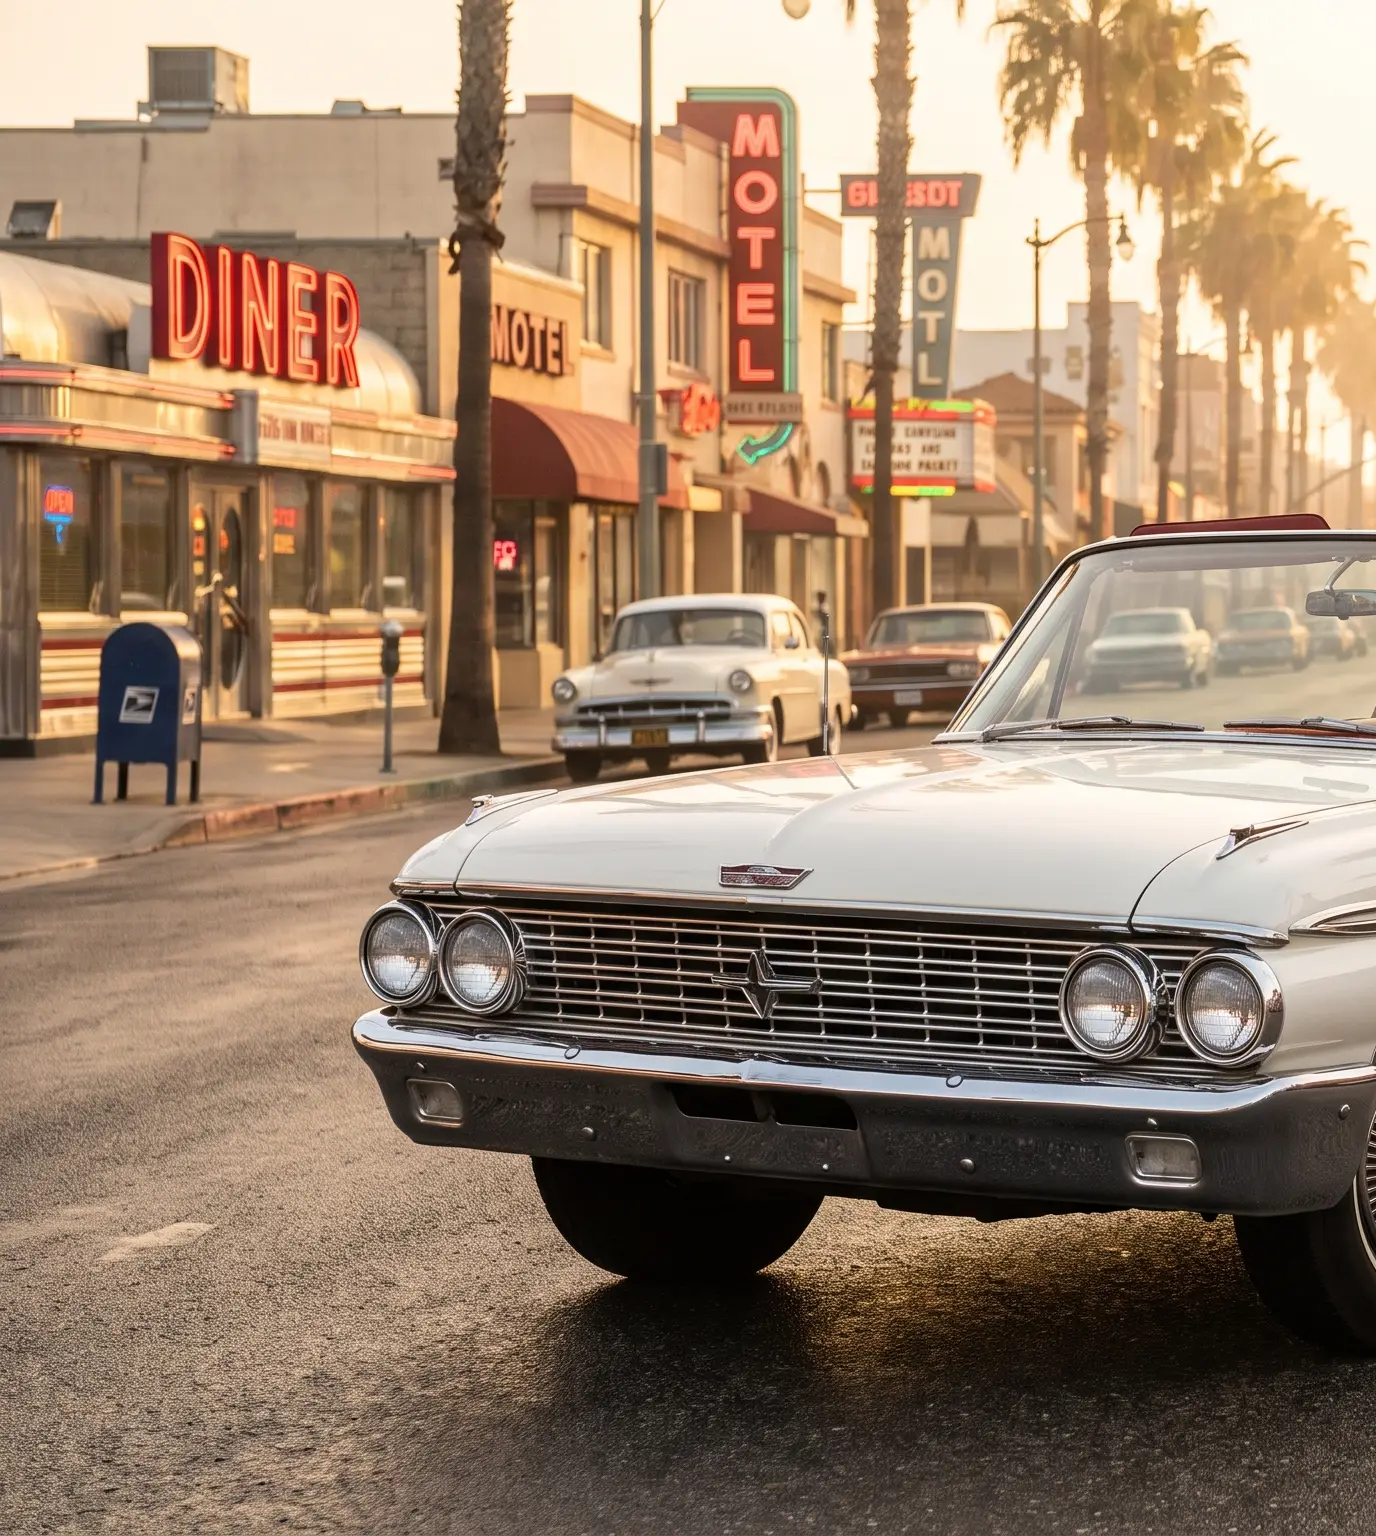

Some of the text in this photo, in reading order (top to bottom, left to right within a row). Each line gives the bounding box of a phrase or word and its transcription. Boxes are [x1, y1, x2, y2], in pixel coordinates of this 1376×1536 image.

[166, 233, 360, 388] DINER
[732, 114, 780, 382] MOTEL
[917, 226, 951, 386] MOTL
[490, 304, 575, 377] MOTEL
